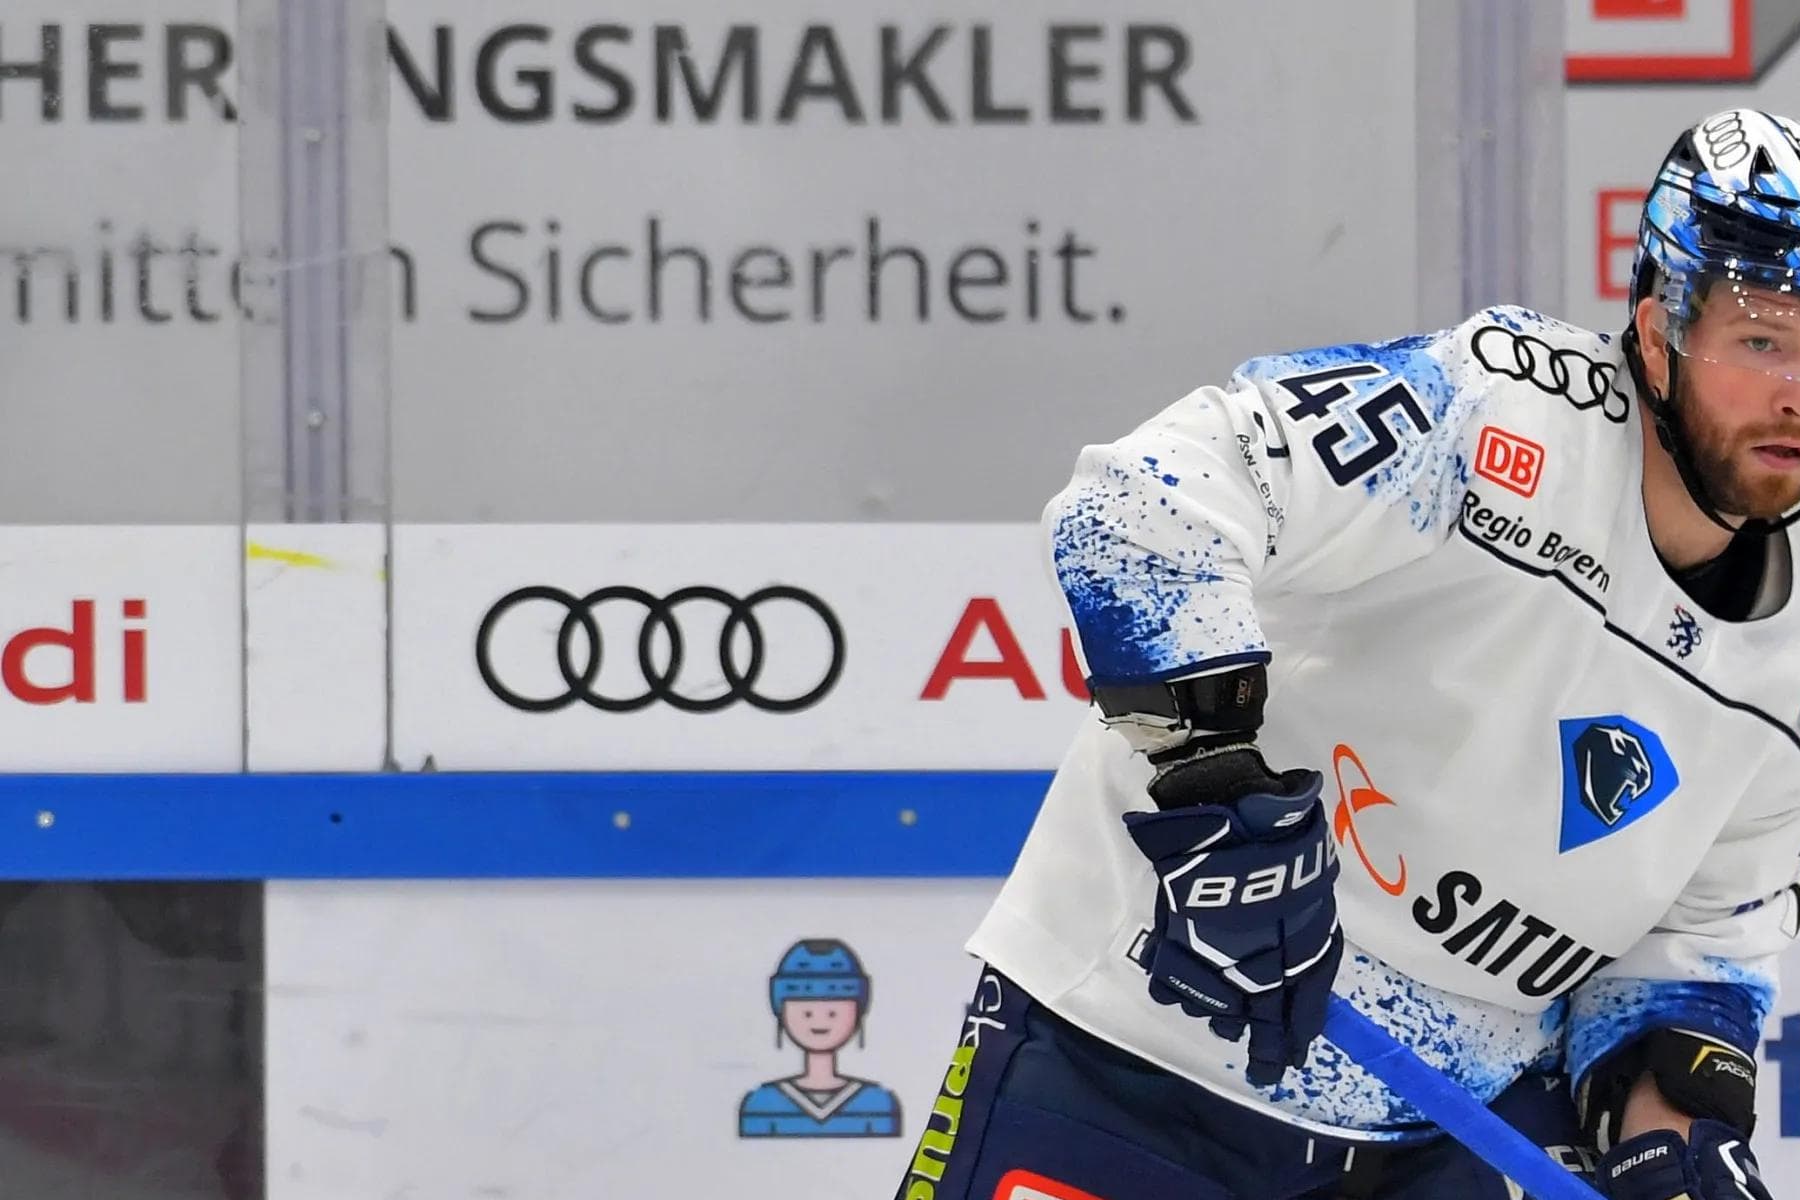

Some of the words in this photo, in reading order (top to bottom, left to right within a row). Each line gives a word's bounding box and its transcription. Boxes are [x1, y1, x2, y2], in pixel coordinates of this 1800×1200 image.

[0, 23, 1197, 125] HERNGSMAKLER
[468, 216, 1128, 325] Sicherheit.
[1278, 364, 1432, 487] 45
[1486, 436, 1538, 487] DB
[1462, 489, 1532, 549] Regio
